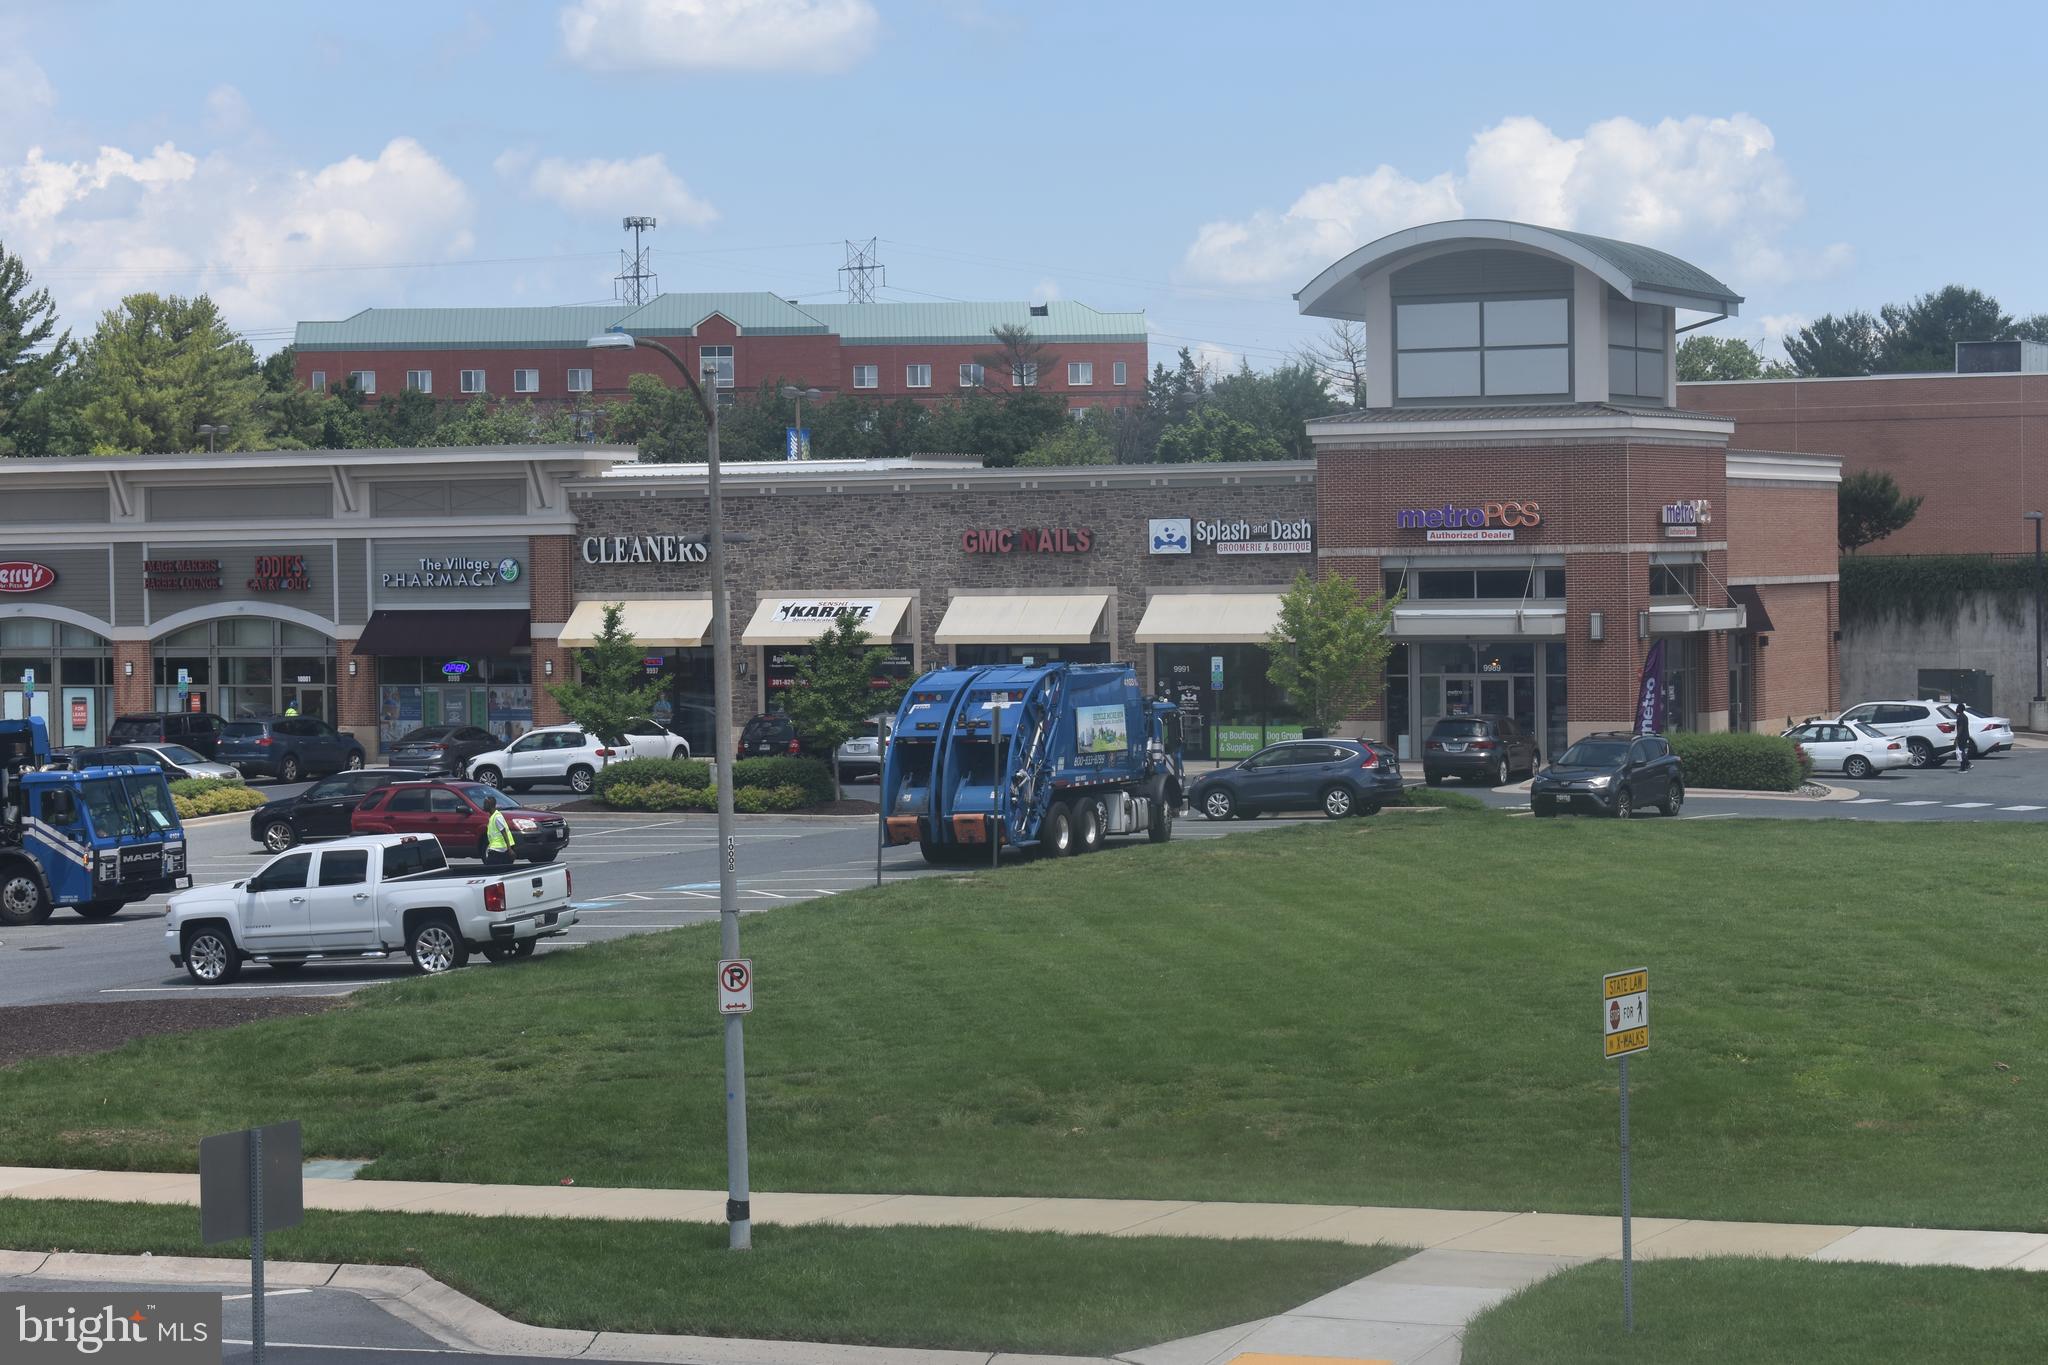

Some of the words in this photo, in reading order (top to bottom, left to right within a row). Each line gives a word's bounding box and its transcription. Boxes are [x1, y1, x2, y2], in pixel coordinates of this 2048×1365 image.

[1397, 502, 1540, 528] metroPCS
[1196, 519, 1249, 545] Splash
[1253, 523, 1268, 534] and
[1271, 519, 1312, 540] Dash
[1430, 532, 1479, 540] Authorized
[1481, 531, 1512, 540] Dealer
[962, 529, 1013, 553] GMC
[1021, 528, 1091, 552] NAILS
[1218, 543, 1262, 552] GROOMERIE
[1265, 542, 1270, 552] &
[1272, 542, 1311, 552] BOUTIQUE
[582, 535, 708, 564] CLEANERS
[255, 555, 305, 578] EDDIE'S
[420, 558, 442, 570] The
[446, 557, 491, 572] Village
[287, 578, 310, 591] OUT
[382, 572, 497, 587] PHARMACY
[790, 606, 873, 618] KARATE
[443, 662, 467, 673] OPEN
[1173, 665, 1190, 673] 9991
[1229, 731, 1259, 741] Boutique
[1266, 731, 1280, 741] Dog
[1226, 743, 1255, 753] Supplies
[123, 851, 162, 863] MACK
[1609, 977, 1628, 995] STATE
[1629, 973, 1643, 991] LAW
[1609, 1008, 1620, 1021] STOP
[1623, 1006, 1634, 1019] FOR
[1616, 1029, 1645, 1051] X-WALKS
